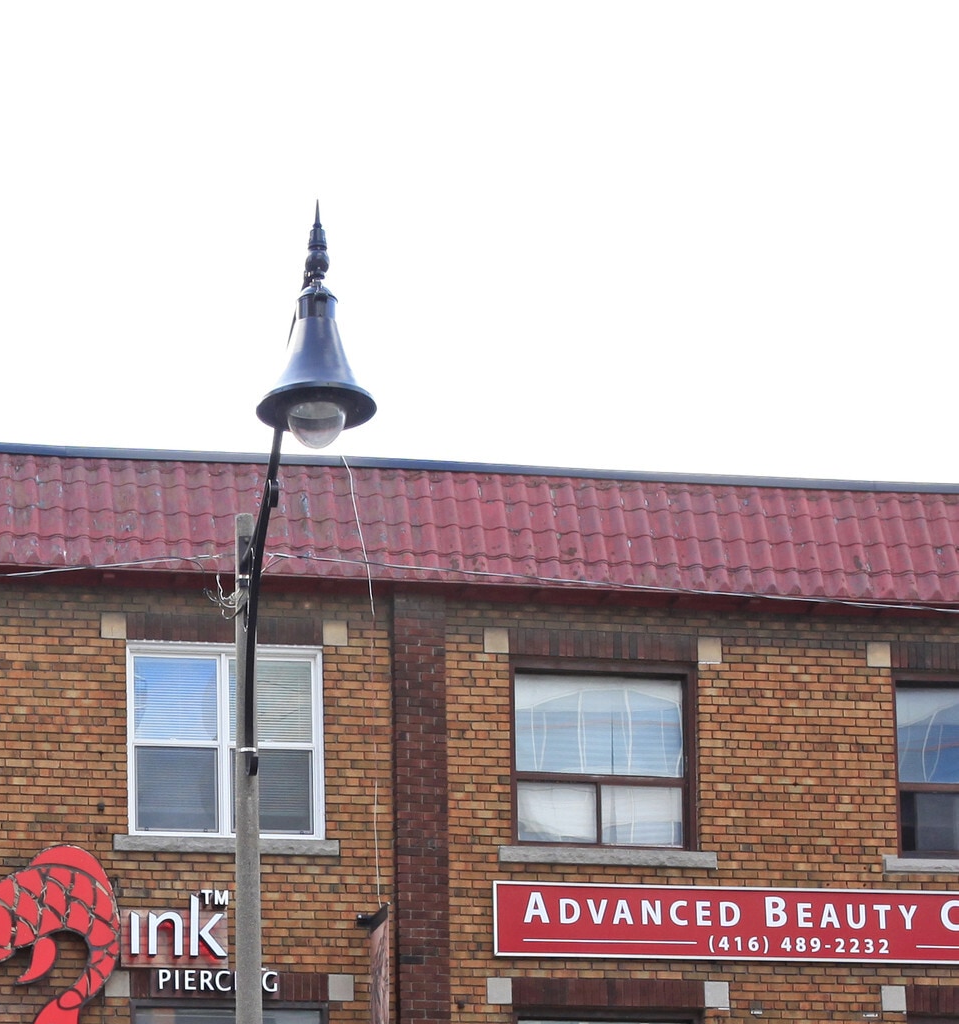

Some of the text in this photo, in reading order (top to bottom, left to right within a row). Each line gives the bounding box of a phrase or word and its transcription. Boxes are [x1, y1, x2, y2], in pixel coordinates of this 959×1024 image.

[130, 894, 227, 957] ink
[523, 891, 741, 927] ADVANCED
[765, 896, 918, 931] BEAUTY
[708, 935, 890, 954] (416) 489-2232
[158, 969, 278, 992] PIERCIG
